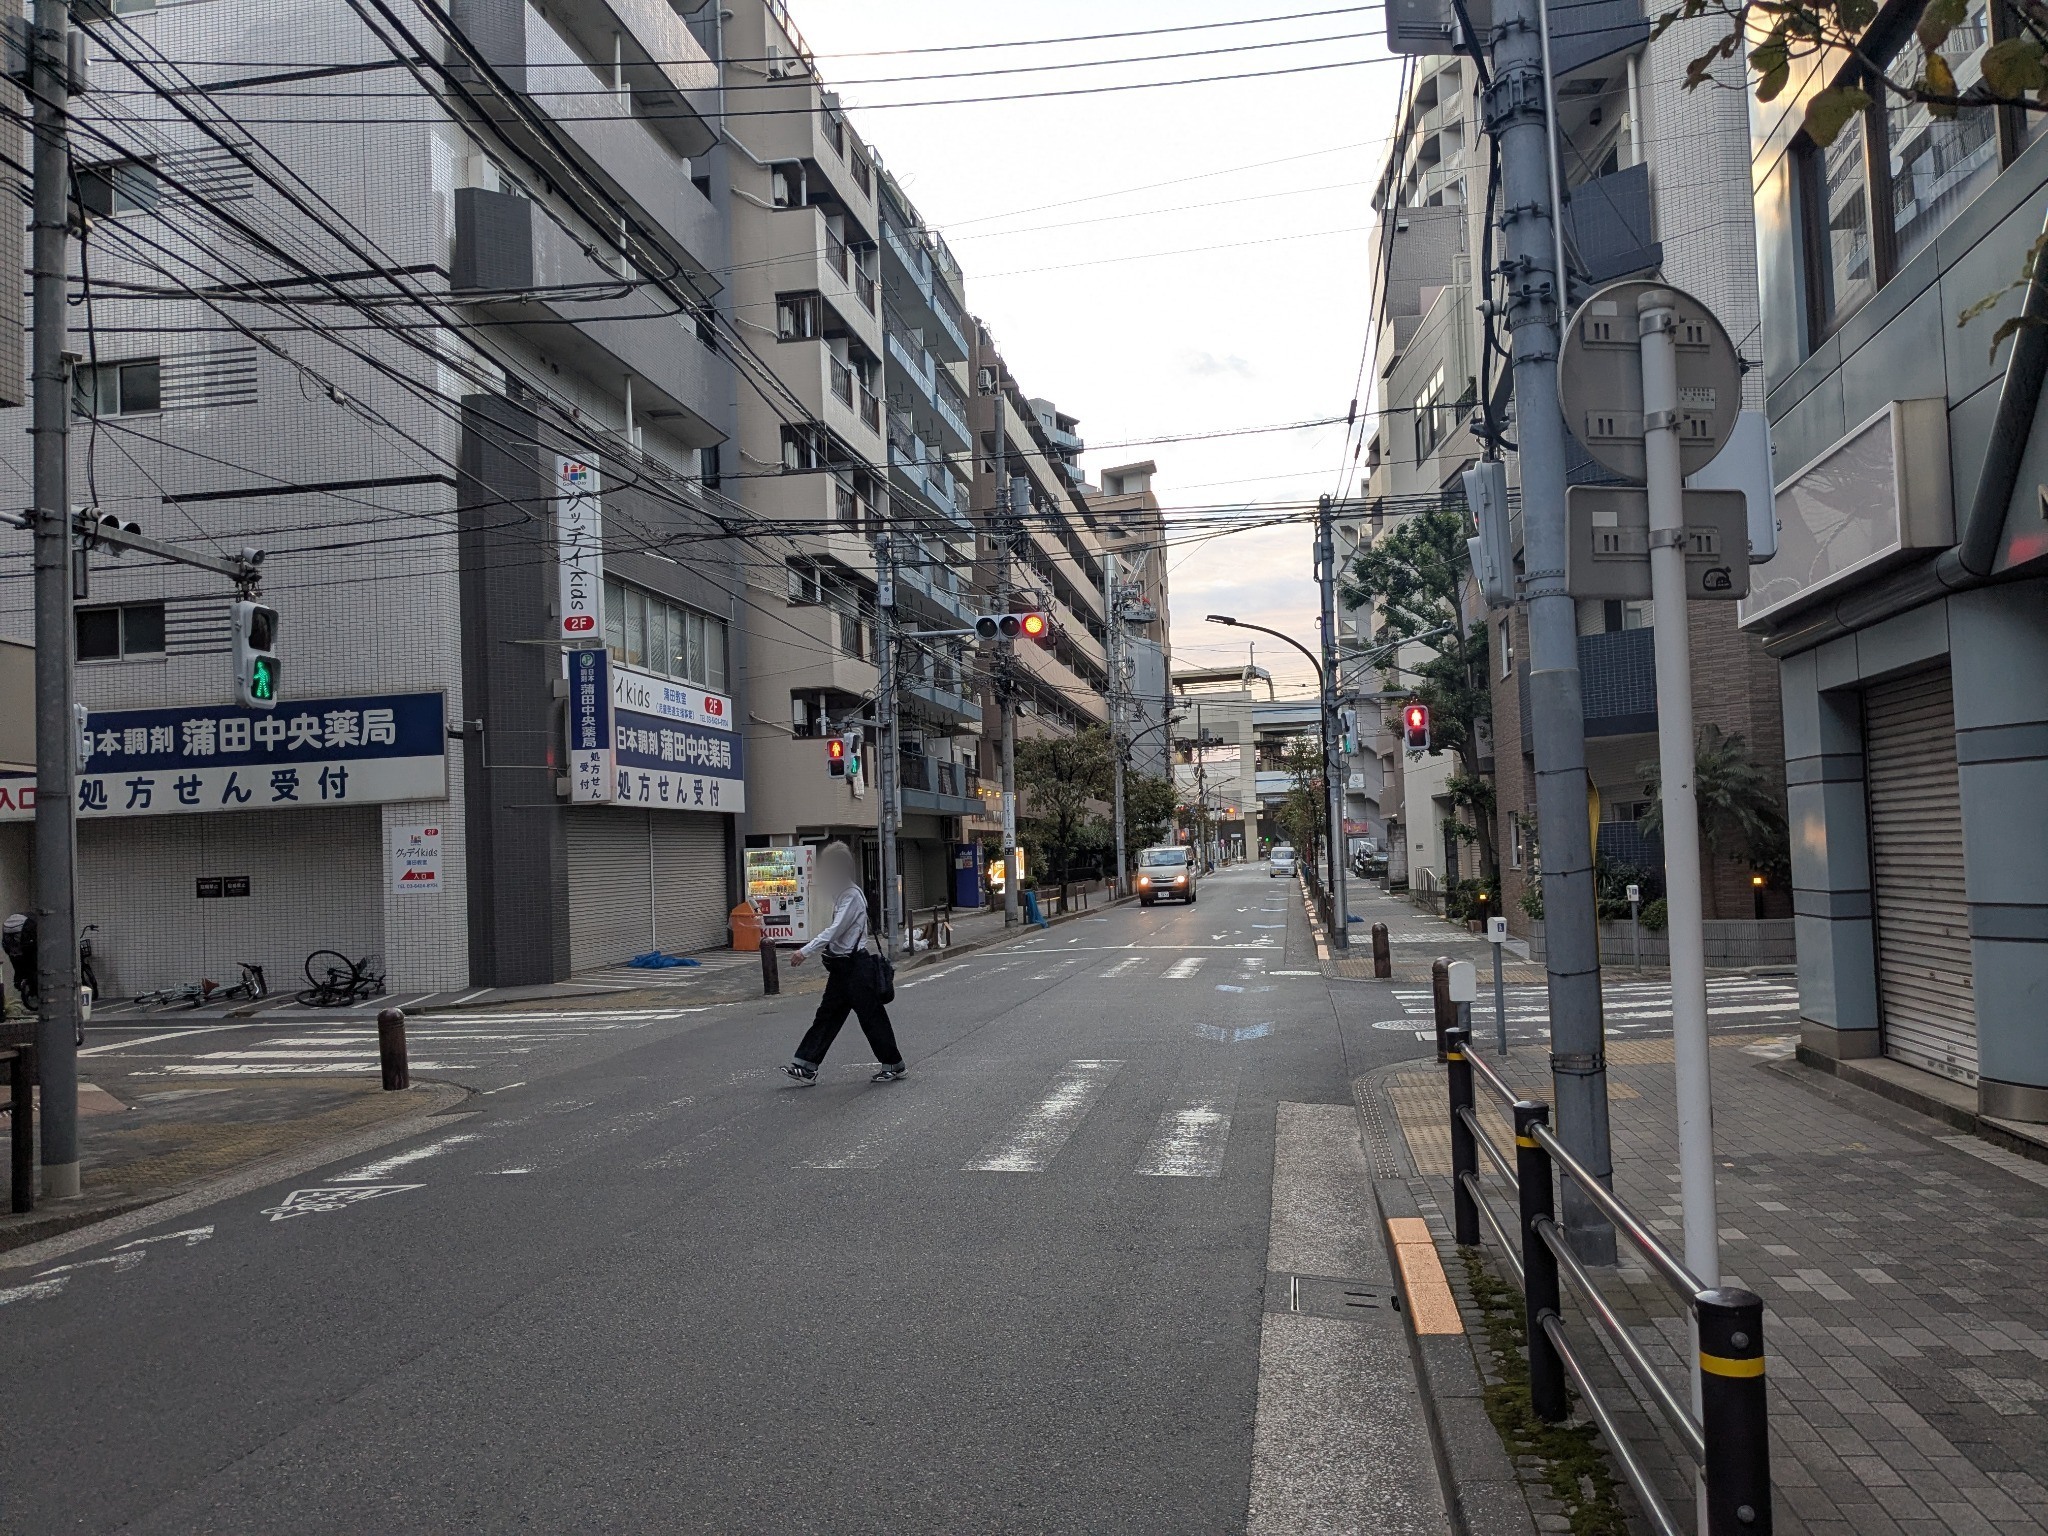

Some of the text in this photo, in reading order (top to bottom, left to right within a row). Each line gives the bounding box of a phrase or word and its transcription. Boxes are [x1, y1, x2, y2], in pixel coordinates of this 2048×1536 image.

[571, 618, 587, 630] 2F
[588, 668, 595, 682] 日本
[613, 676, 651, 709] イkids
[708, 698, 718, 714] 2F
[580, 683, 597, 748] 蒲田中央薬局
[182, 708, 396, 757] 蒲田中央薬局
[616, 725, 732, 770] 日本調剤 蒲田中央薬局
[78, 765, 349, 812] 処方せん受付
[579, 762, 590, 791] 受付
[590, 751, 602, 799] 処方せん
[617, 769, 720, 807] 処方せん受付
[0, 786, 37, 812] 入口
[760, 927, 793, 938] KIRIN
